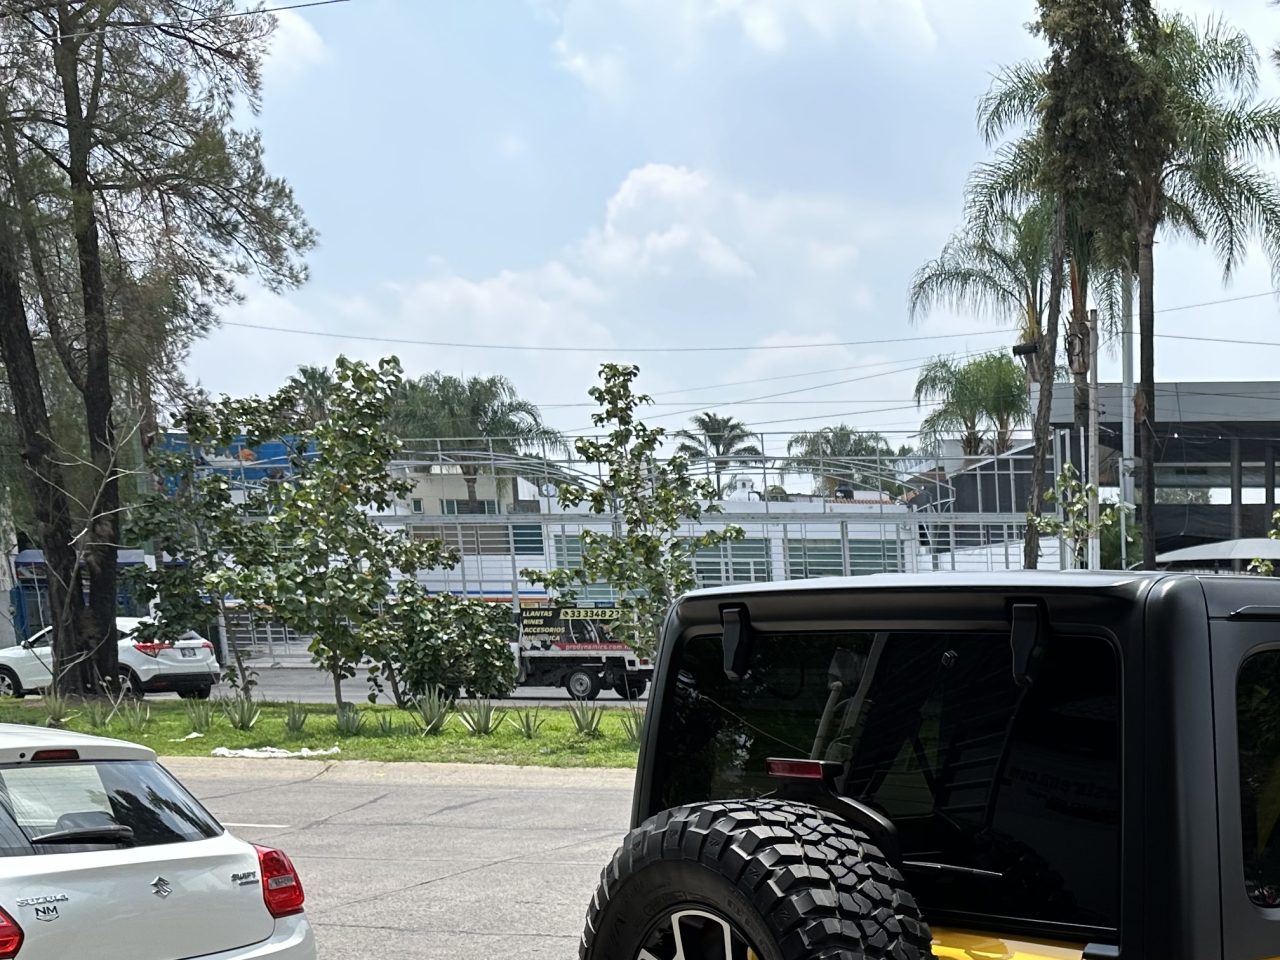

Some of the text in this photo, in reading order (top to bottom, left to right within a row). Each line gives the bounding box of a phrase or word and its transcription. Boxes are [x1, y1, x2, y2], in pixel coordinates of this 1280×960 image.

[569, 610, 581, 618] 33
[583, 610, 606, 618] 3348
[35, 905, 59, 917] NM
